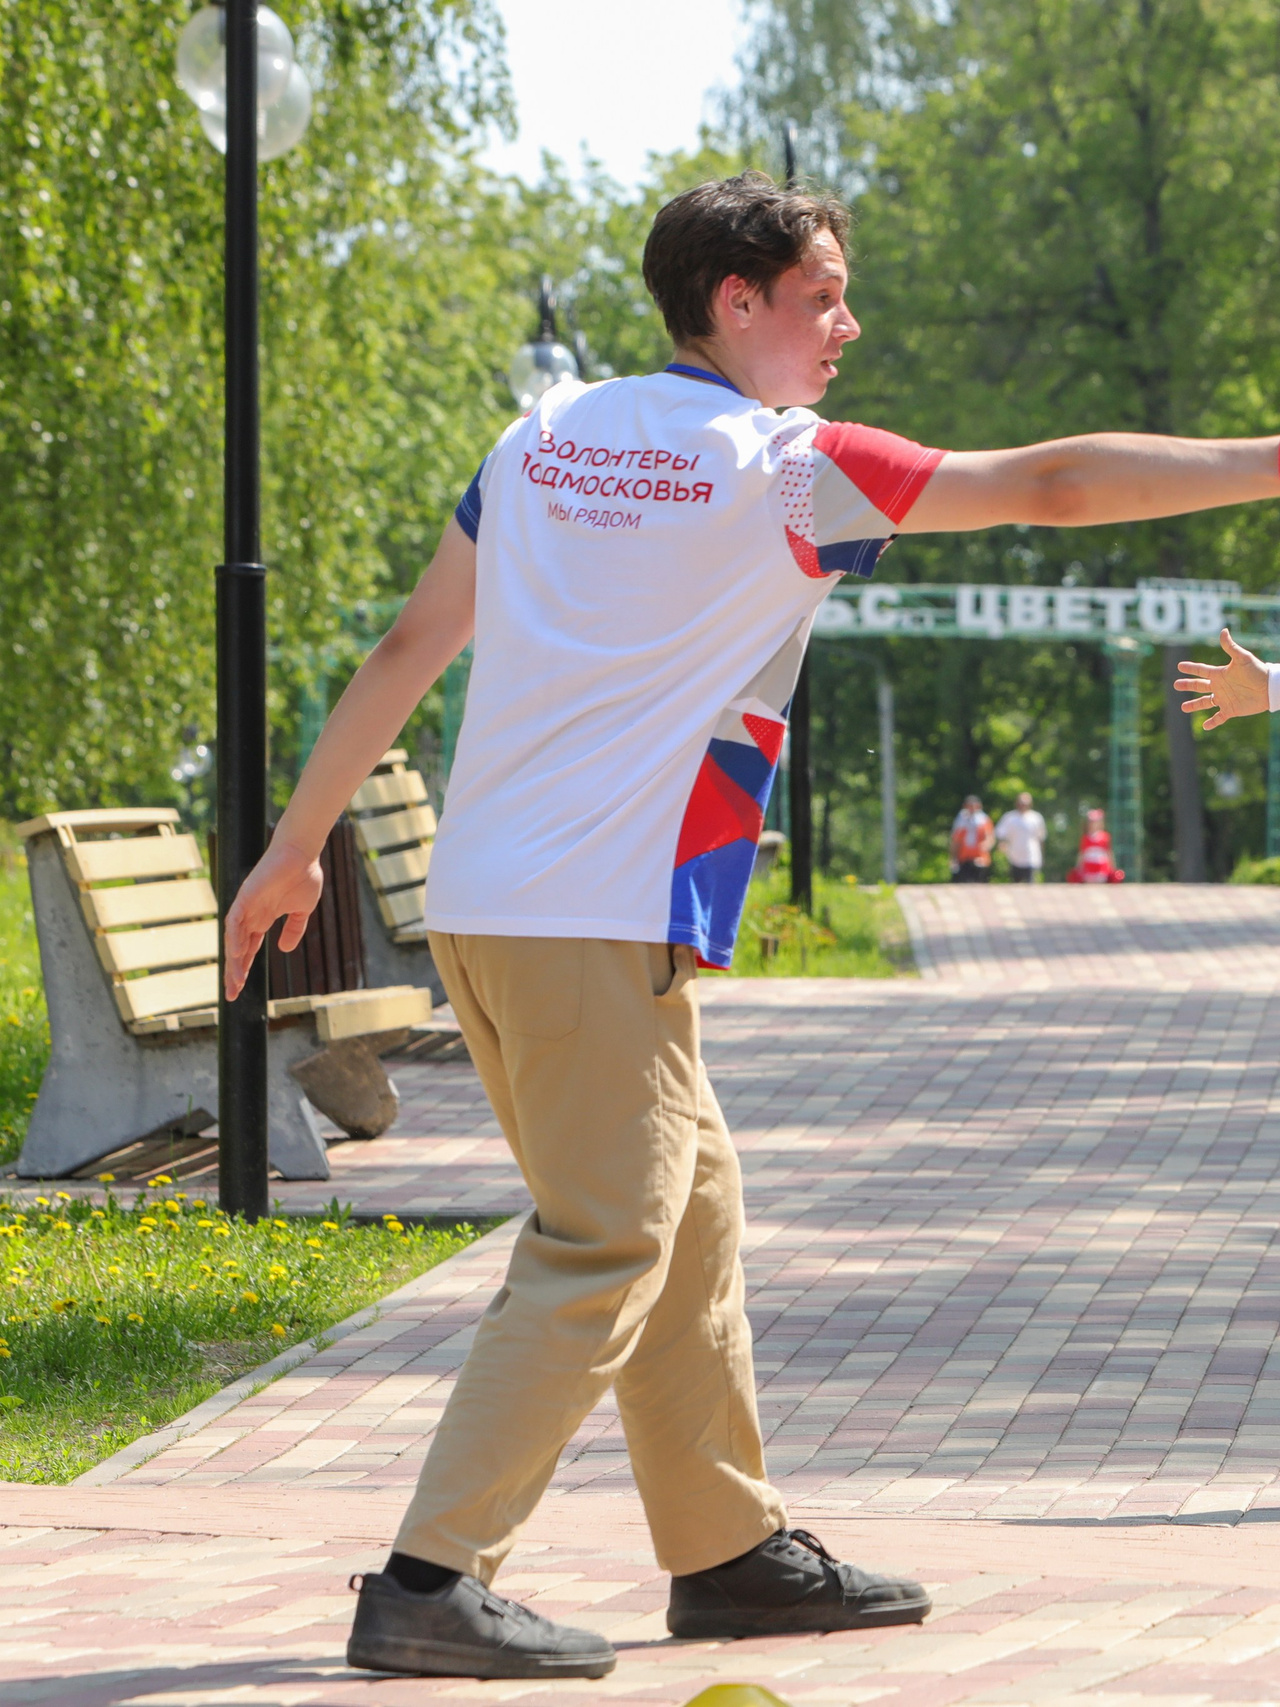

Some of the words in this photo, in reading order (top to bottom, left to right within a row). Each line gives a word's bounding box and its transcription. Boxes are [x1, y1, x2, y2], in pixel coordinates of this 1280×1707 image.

[547, 501, 573, 522] МЫ
[574, 508, 642, 530] РЯДОМ
[956, 583, 1225, 639] ЦВЕТОВ
